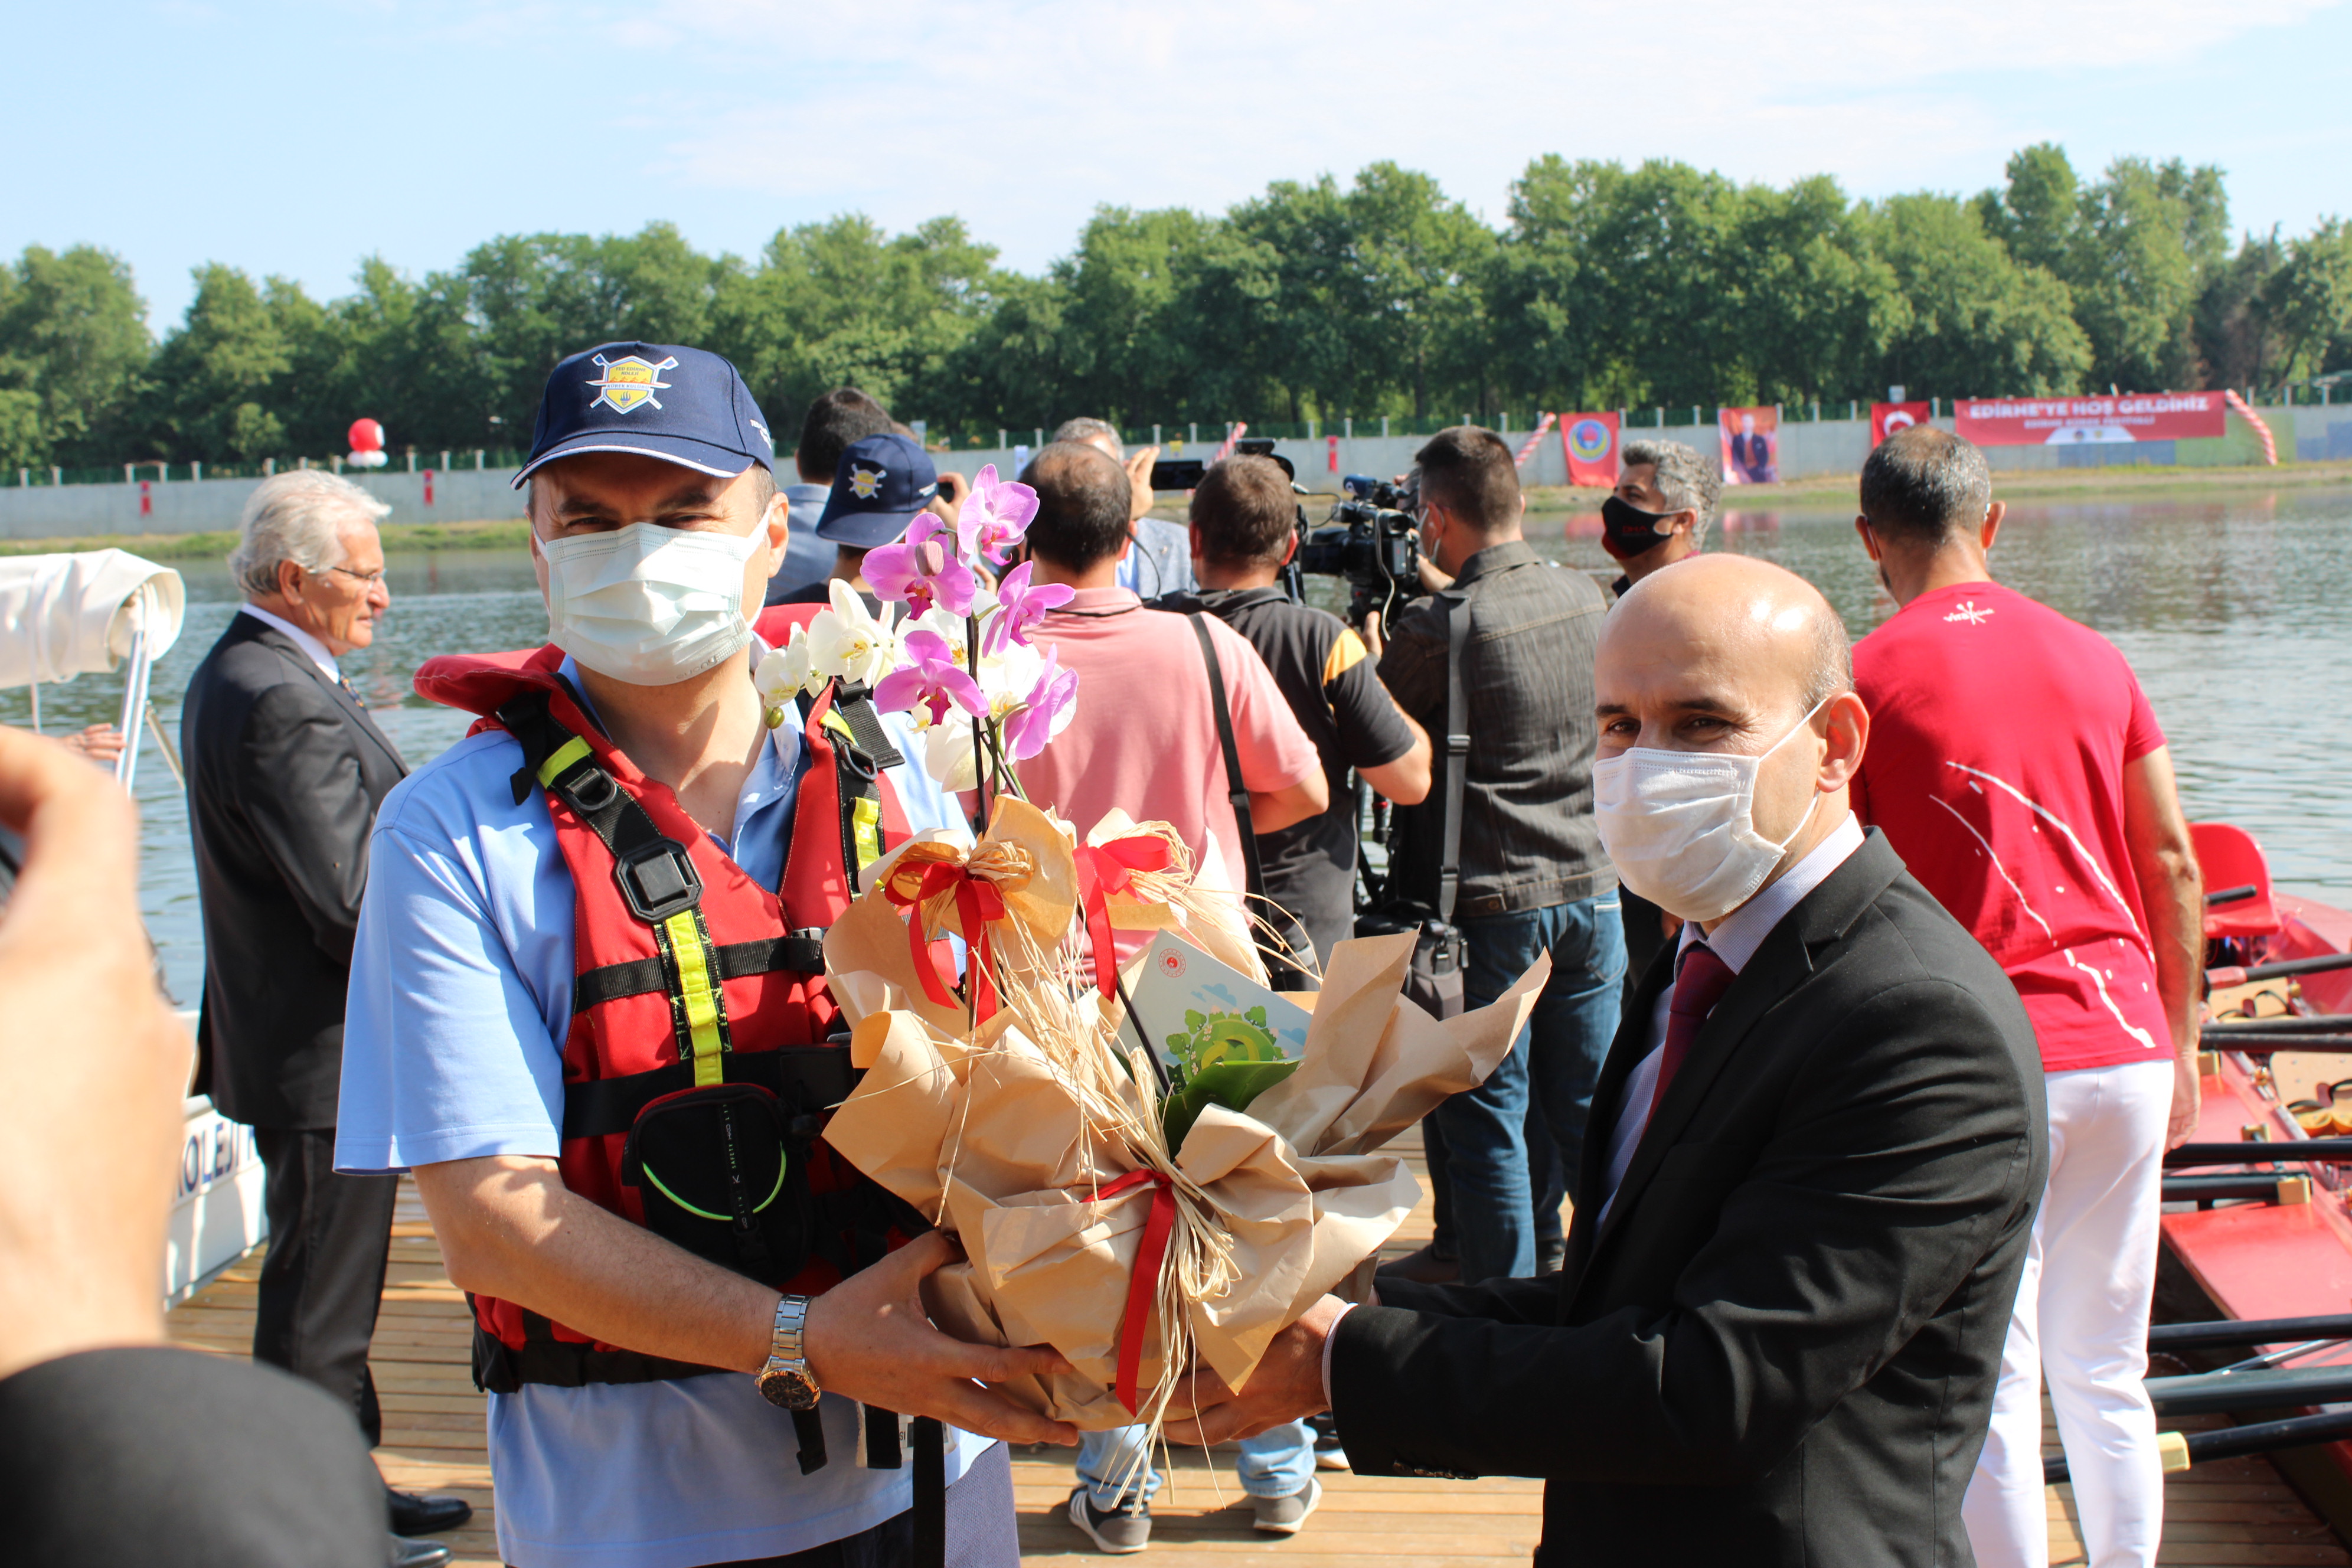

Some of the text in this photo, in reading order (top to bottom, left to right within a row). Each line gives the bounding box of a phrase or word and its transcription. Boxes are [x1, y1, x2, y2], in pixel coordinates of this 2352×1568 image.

[1969, 395, 2210, 419] EDİRNE'YE HOŞ GELDİNİZ
